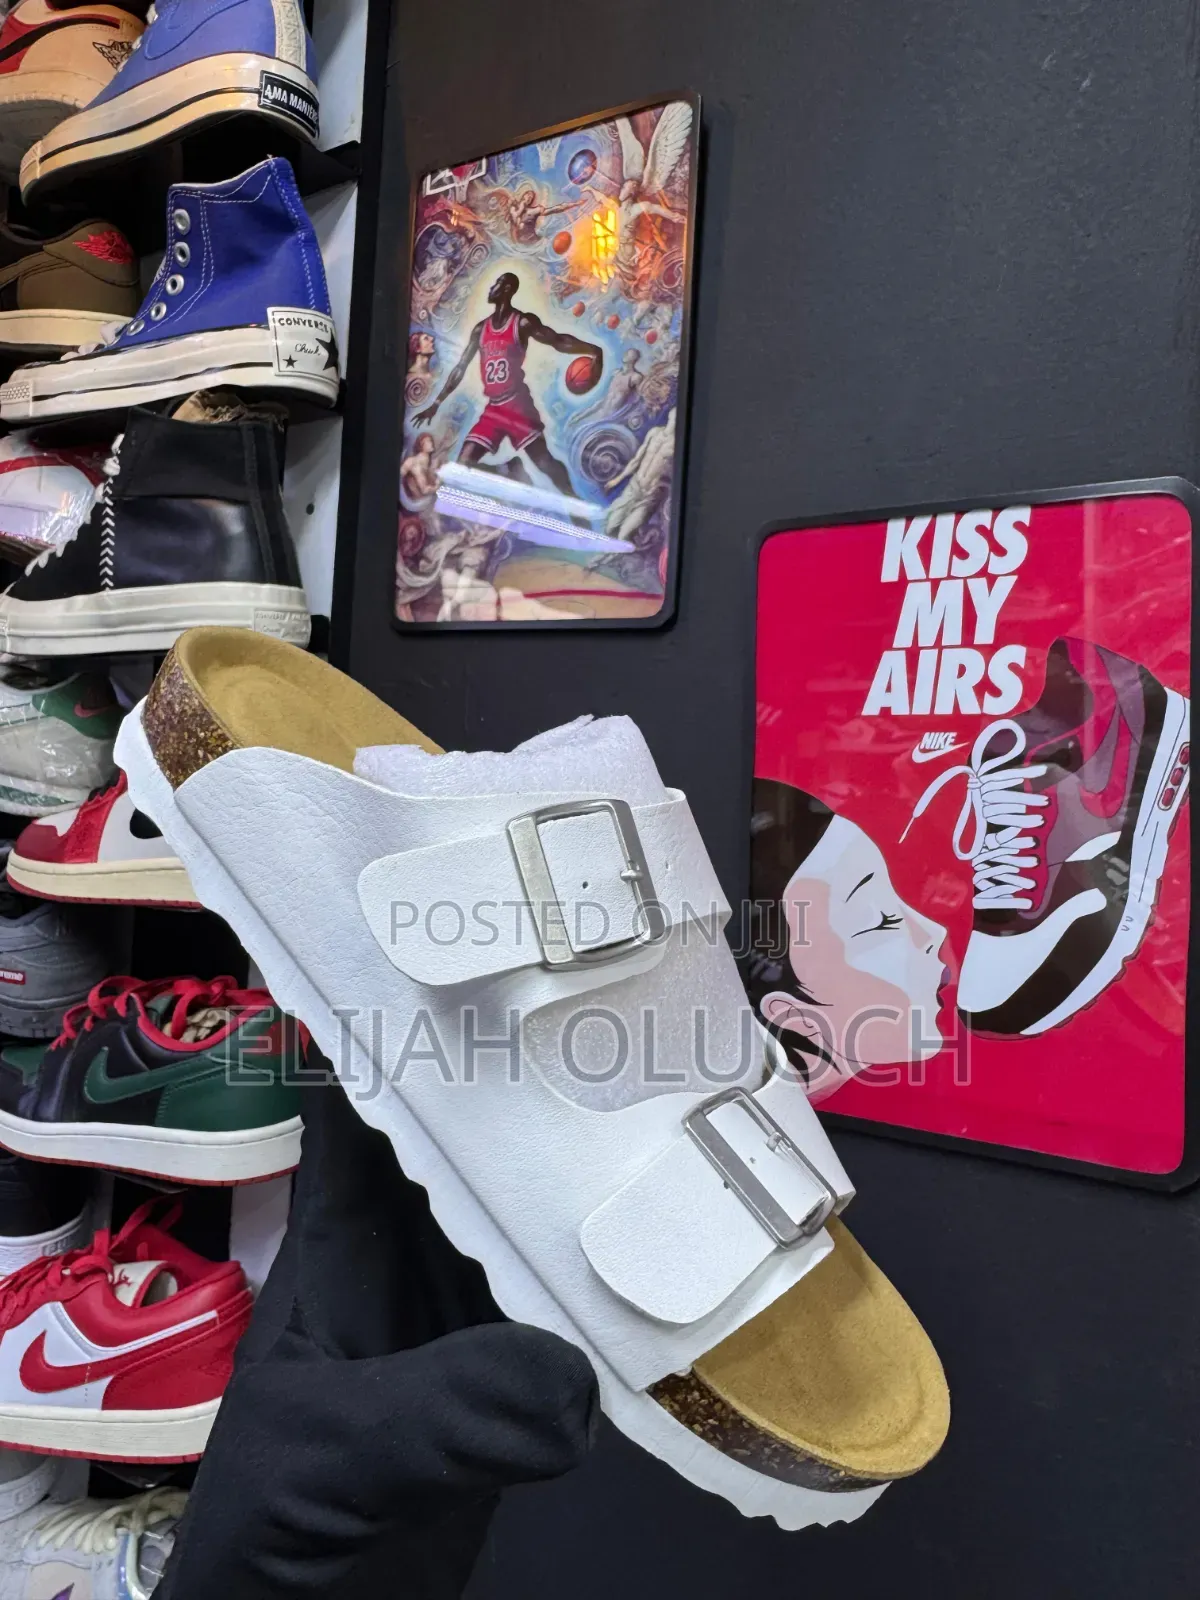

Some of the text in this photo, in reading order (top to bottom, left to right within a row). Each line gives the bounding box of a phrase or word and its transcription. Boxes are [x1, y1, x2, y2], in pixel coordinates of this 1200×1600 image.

[278, 317, 329, 333] CONVERSE
[485, 358, 510, 385] 23
[880, 504, 1032, 583] KISS
[892, 575, 1018, 649] MY
[861, 644, 1027, 717] AIRS
[919, 731, 958, 751] NIKE
